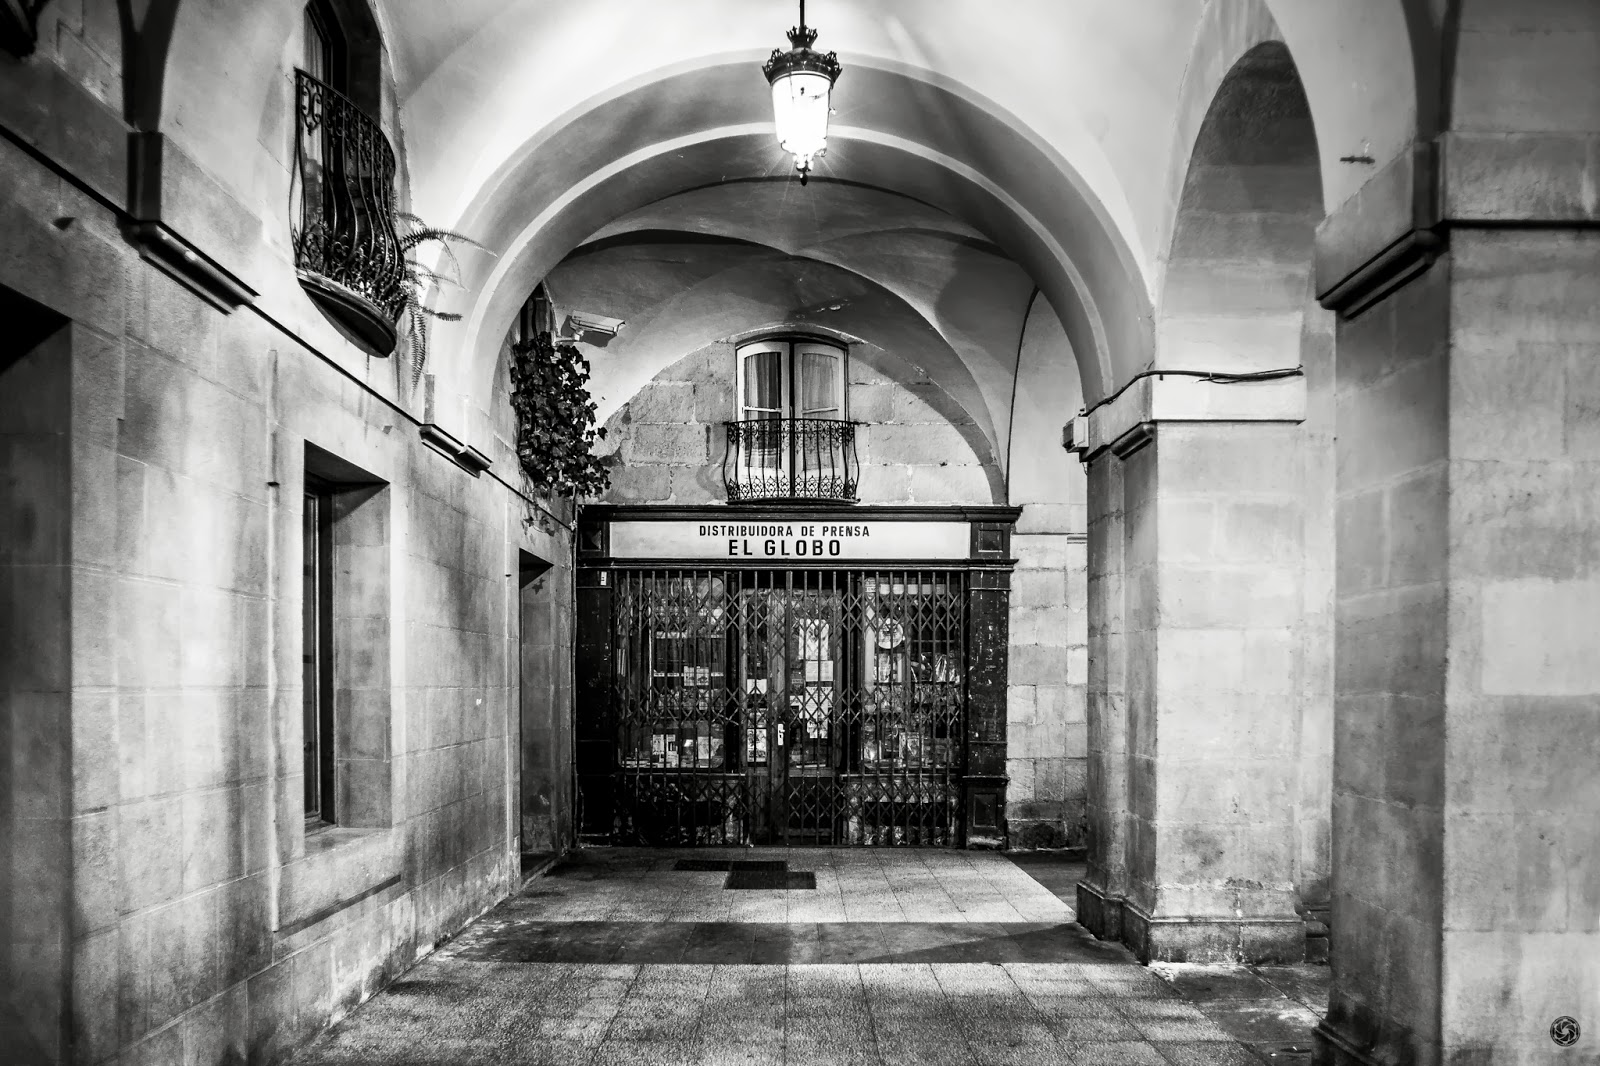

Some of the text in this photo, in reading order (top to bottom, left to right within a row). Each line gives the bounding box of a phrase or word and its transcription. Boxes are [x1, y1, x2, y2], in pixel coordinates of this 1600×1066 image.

[699, 525, 870, 537] DISTRIBUIDORA DE PRENSA
[728, 539, 841, 556] EL GLOBO
